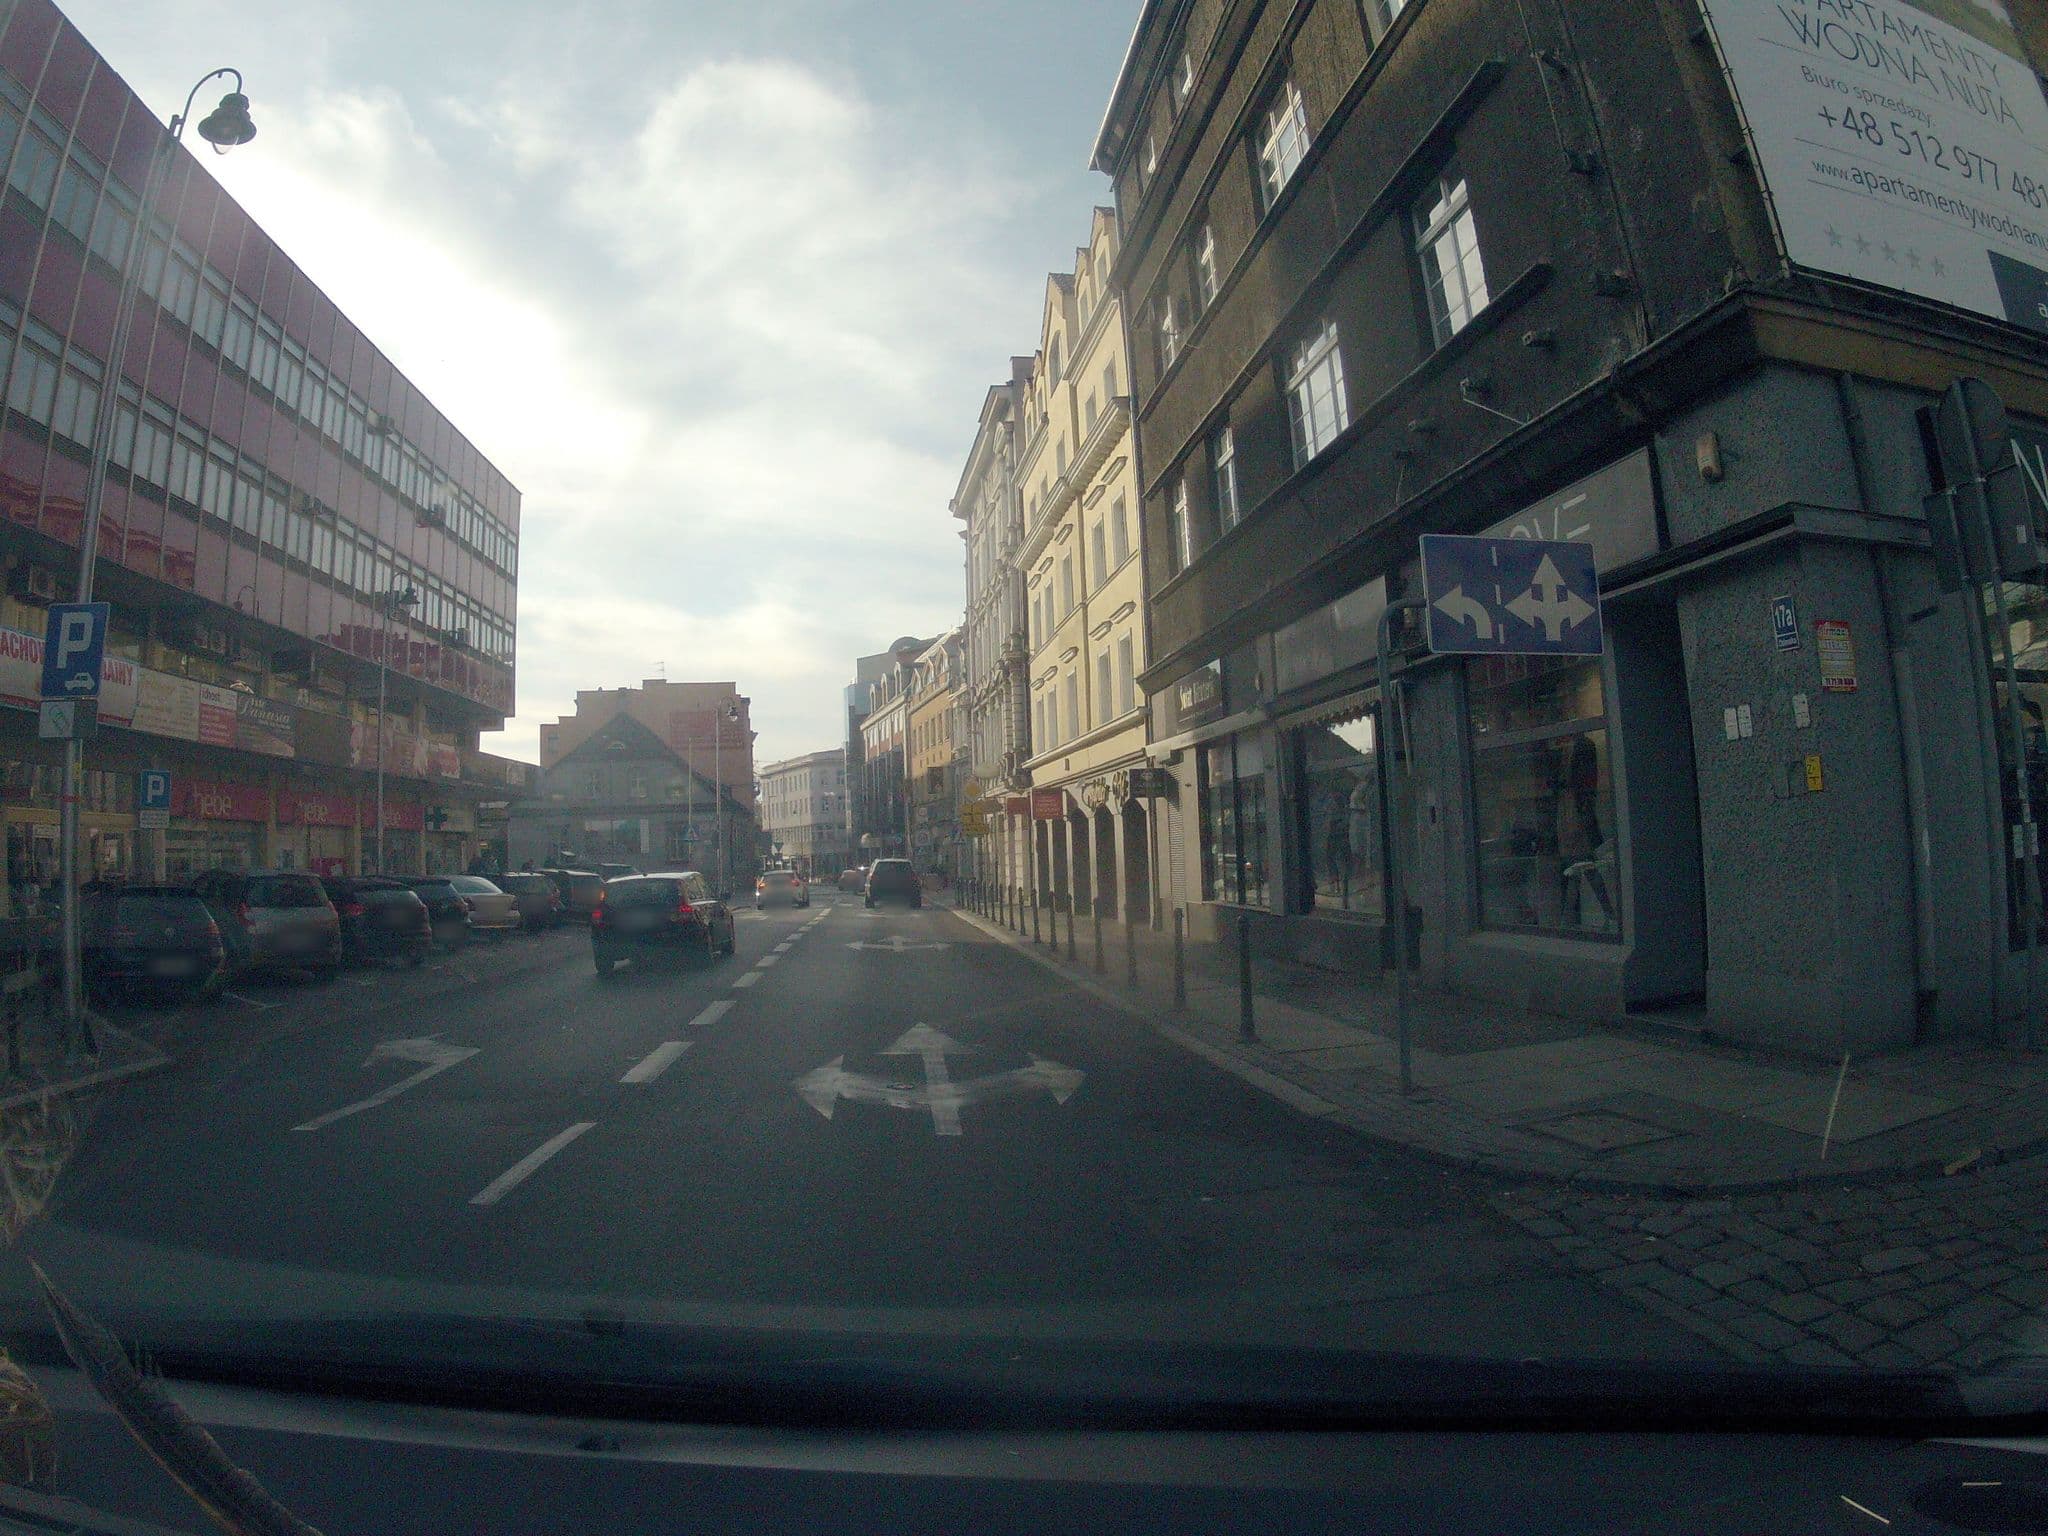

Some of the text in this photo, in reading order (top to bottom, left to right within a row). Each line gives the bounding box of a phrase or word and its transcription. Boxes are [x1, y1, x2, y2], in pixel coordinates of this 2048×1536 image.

[1777, 5, 2024, 134] WODNA NUTA
[1801, 65, 1849, 94] Biuro
[1818, 105, 1884, 147] +48
[1890, 121, 1950, 171] 512
[1953, 145, 2000, 191] 977
[1775, 604, 1793, 628] 17a
[56, 611, 95, 669] P
[147, 774, 165, 803] P
